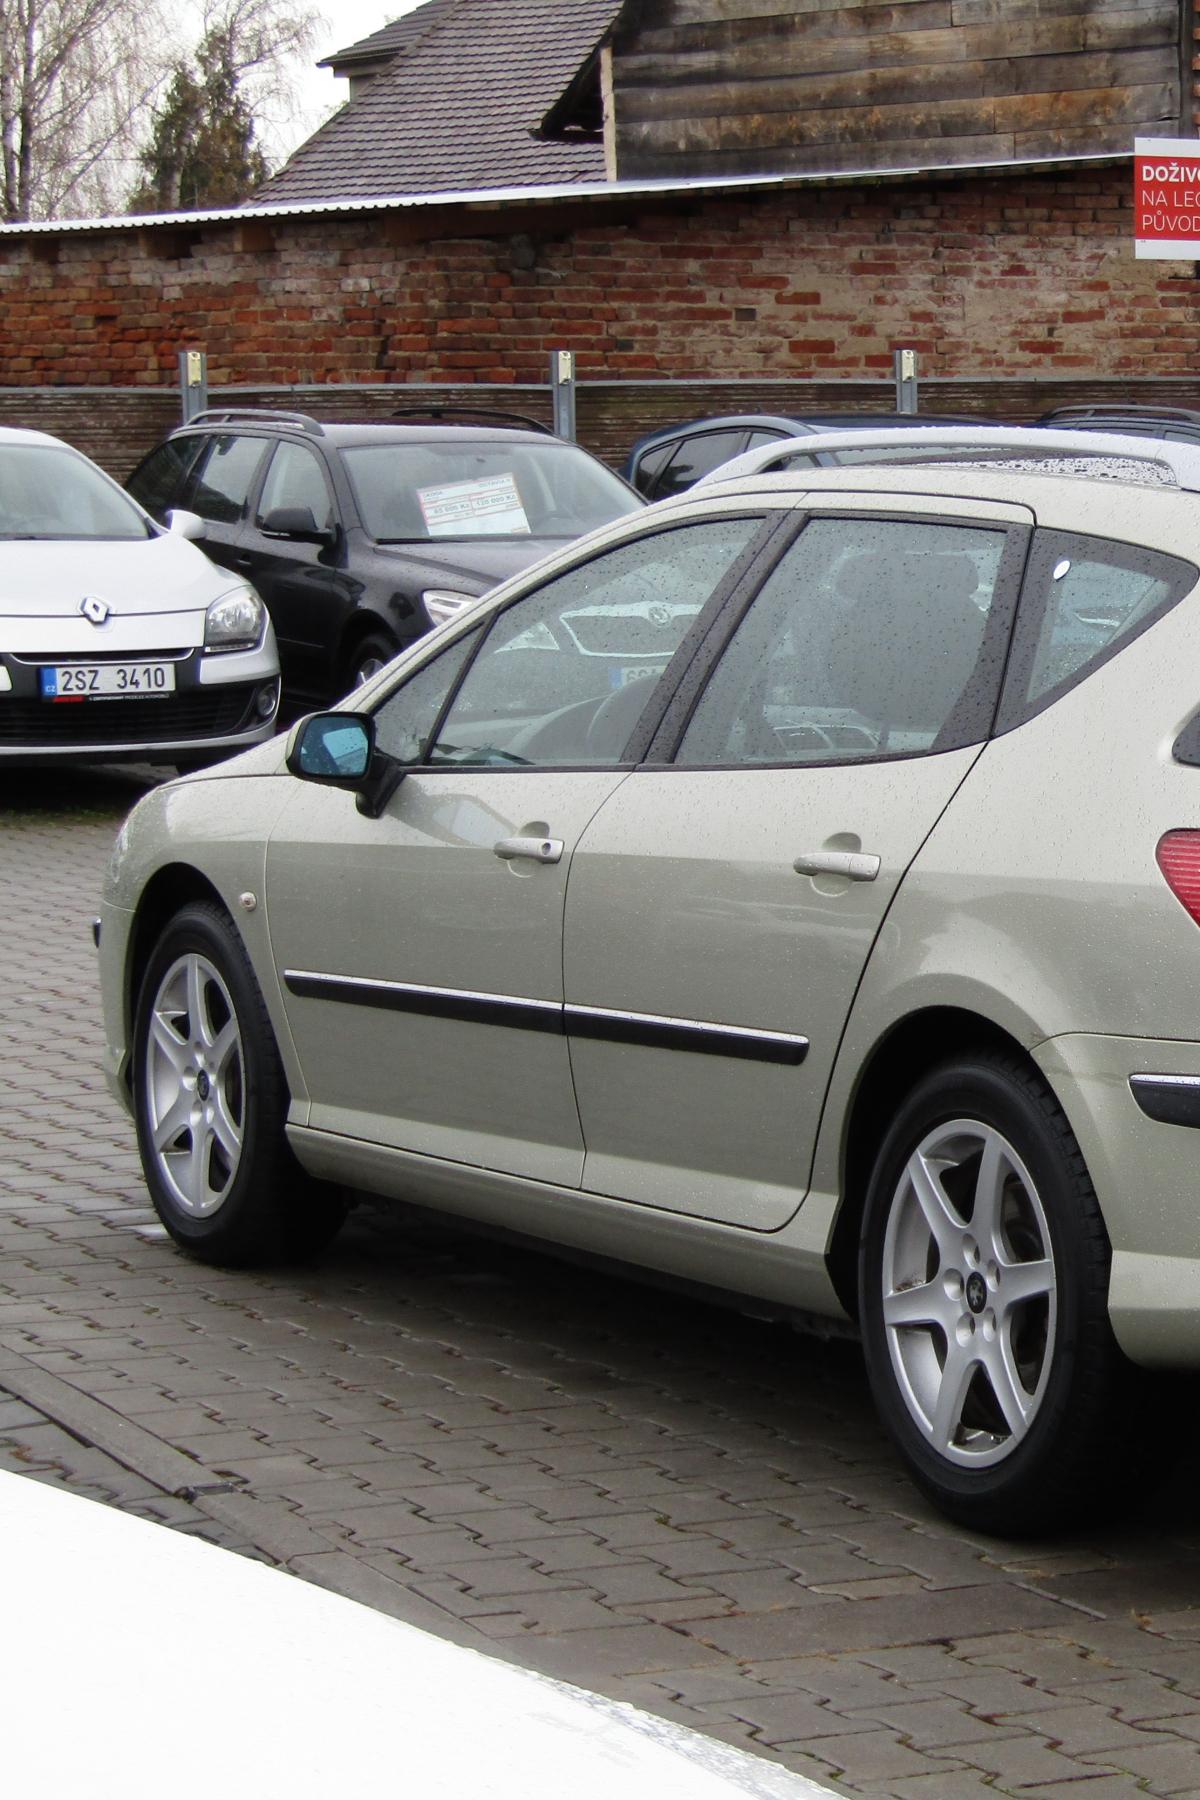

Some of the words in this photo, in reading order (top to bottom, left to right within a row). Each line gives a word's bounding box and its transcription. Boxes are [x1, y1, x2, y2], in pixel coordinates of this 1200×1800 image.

[1142, 189, 1168, 207] NA
[61, 669, 99, 692] 2SZ
[116, 667, 165, 690] 3410
[45, 685, 56, 693] CZ
